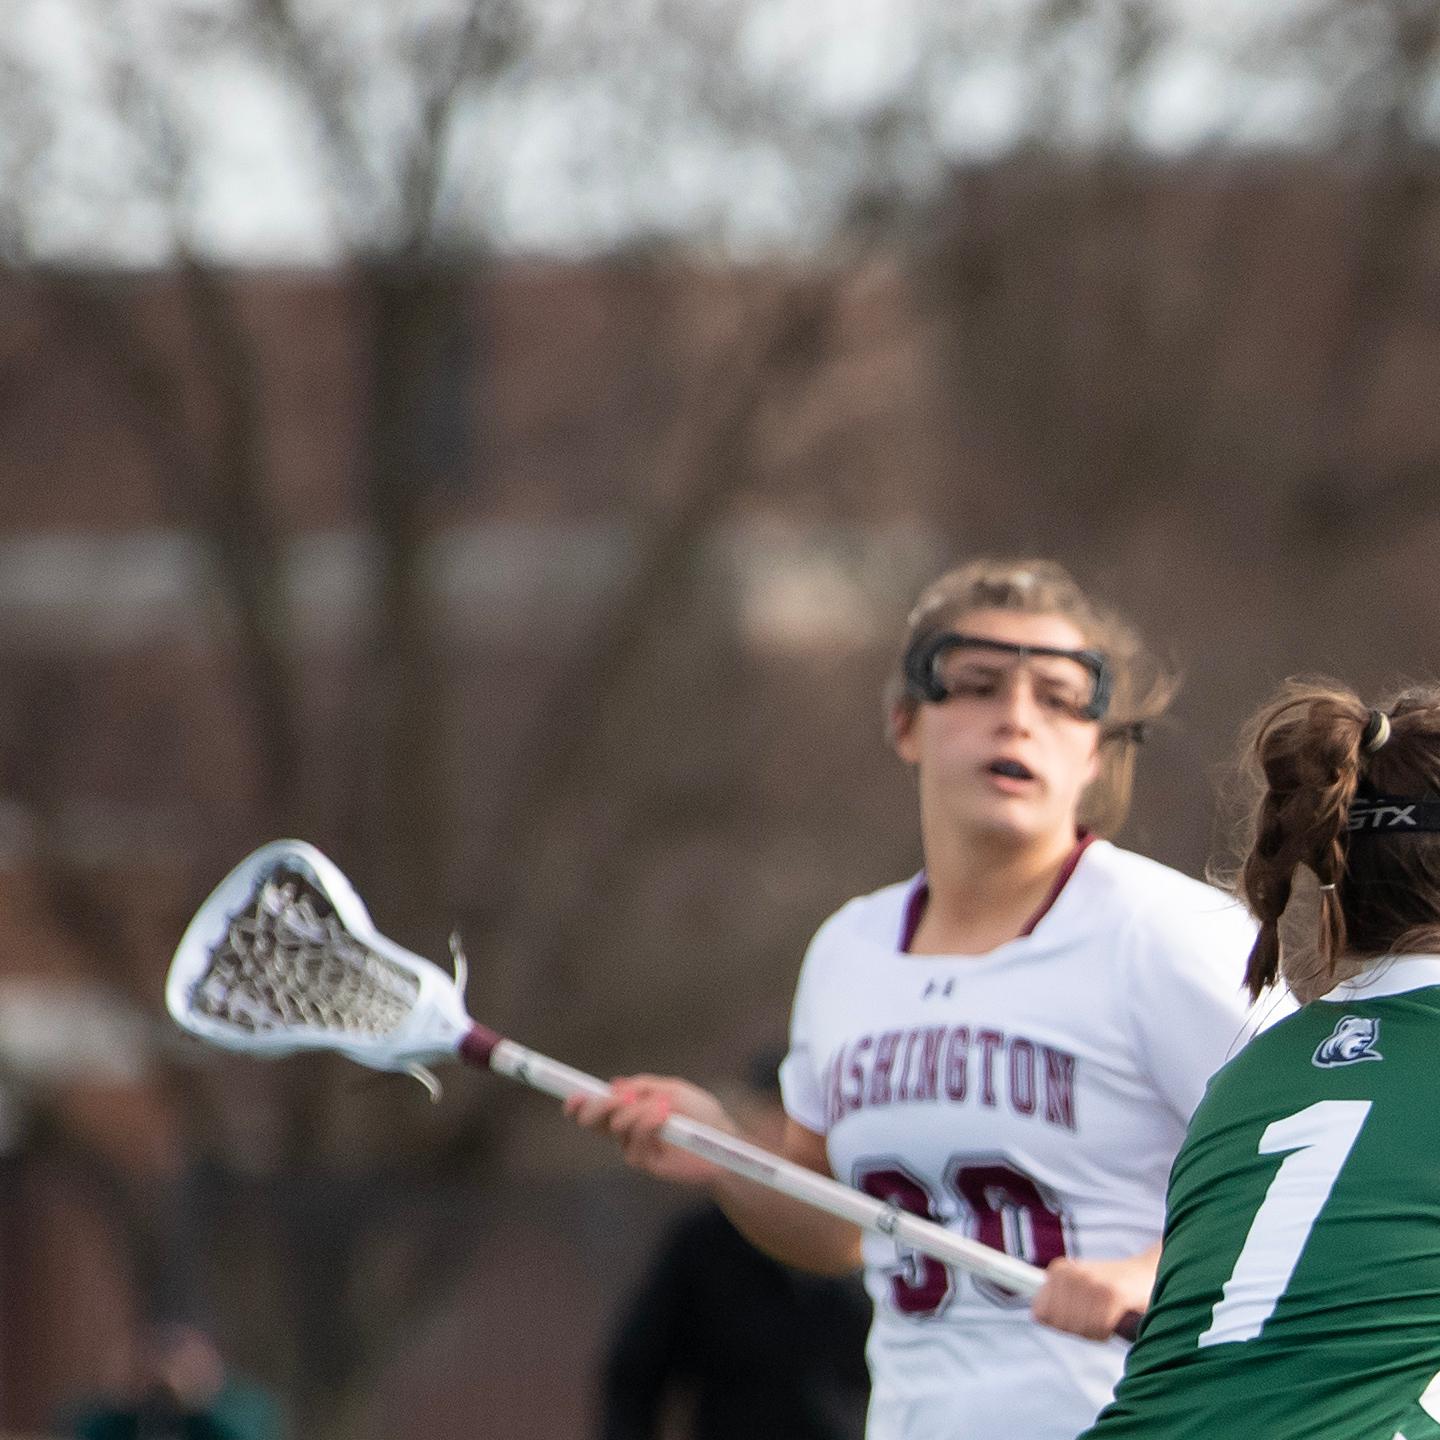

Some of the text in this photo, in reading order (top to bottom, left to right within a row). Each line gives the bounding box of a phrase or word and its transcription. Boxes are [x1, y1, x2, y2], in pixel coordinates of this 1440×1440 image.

[1346, 804, 1417, 830] STX
[825, 1024, 1078, 1137] ASHINGTON
[853, 1153, 1076, 1318] 30
[1198, 1100, 1373, 1348] 1
